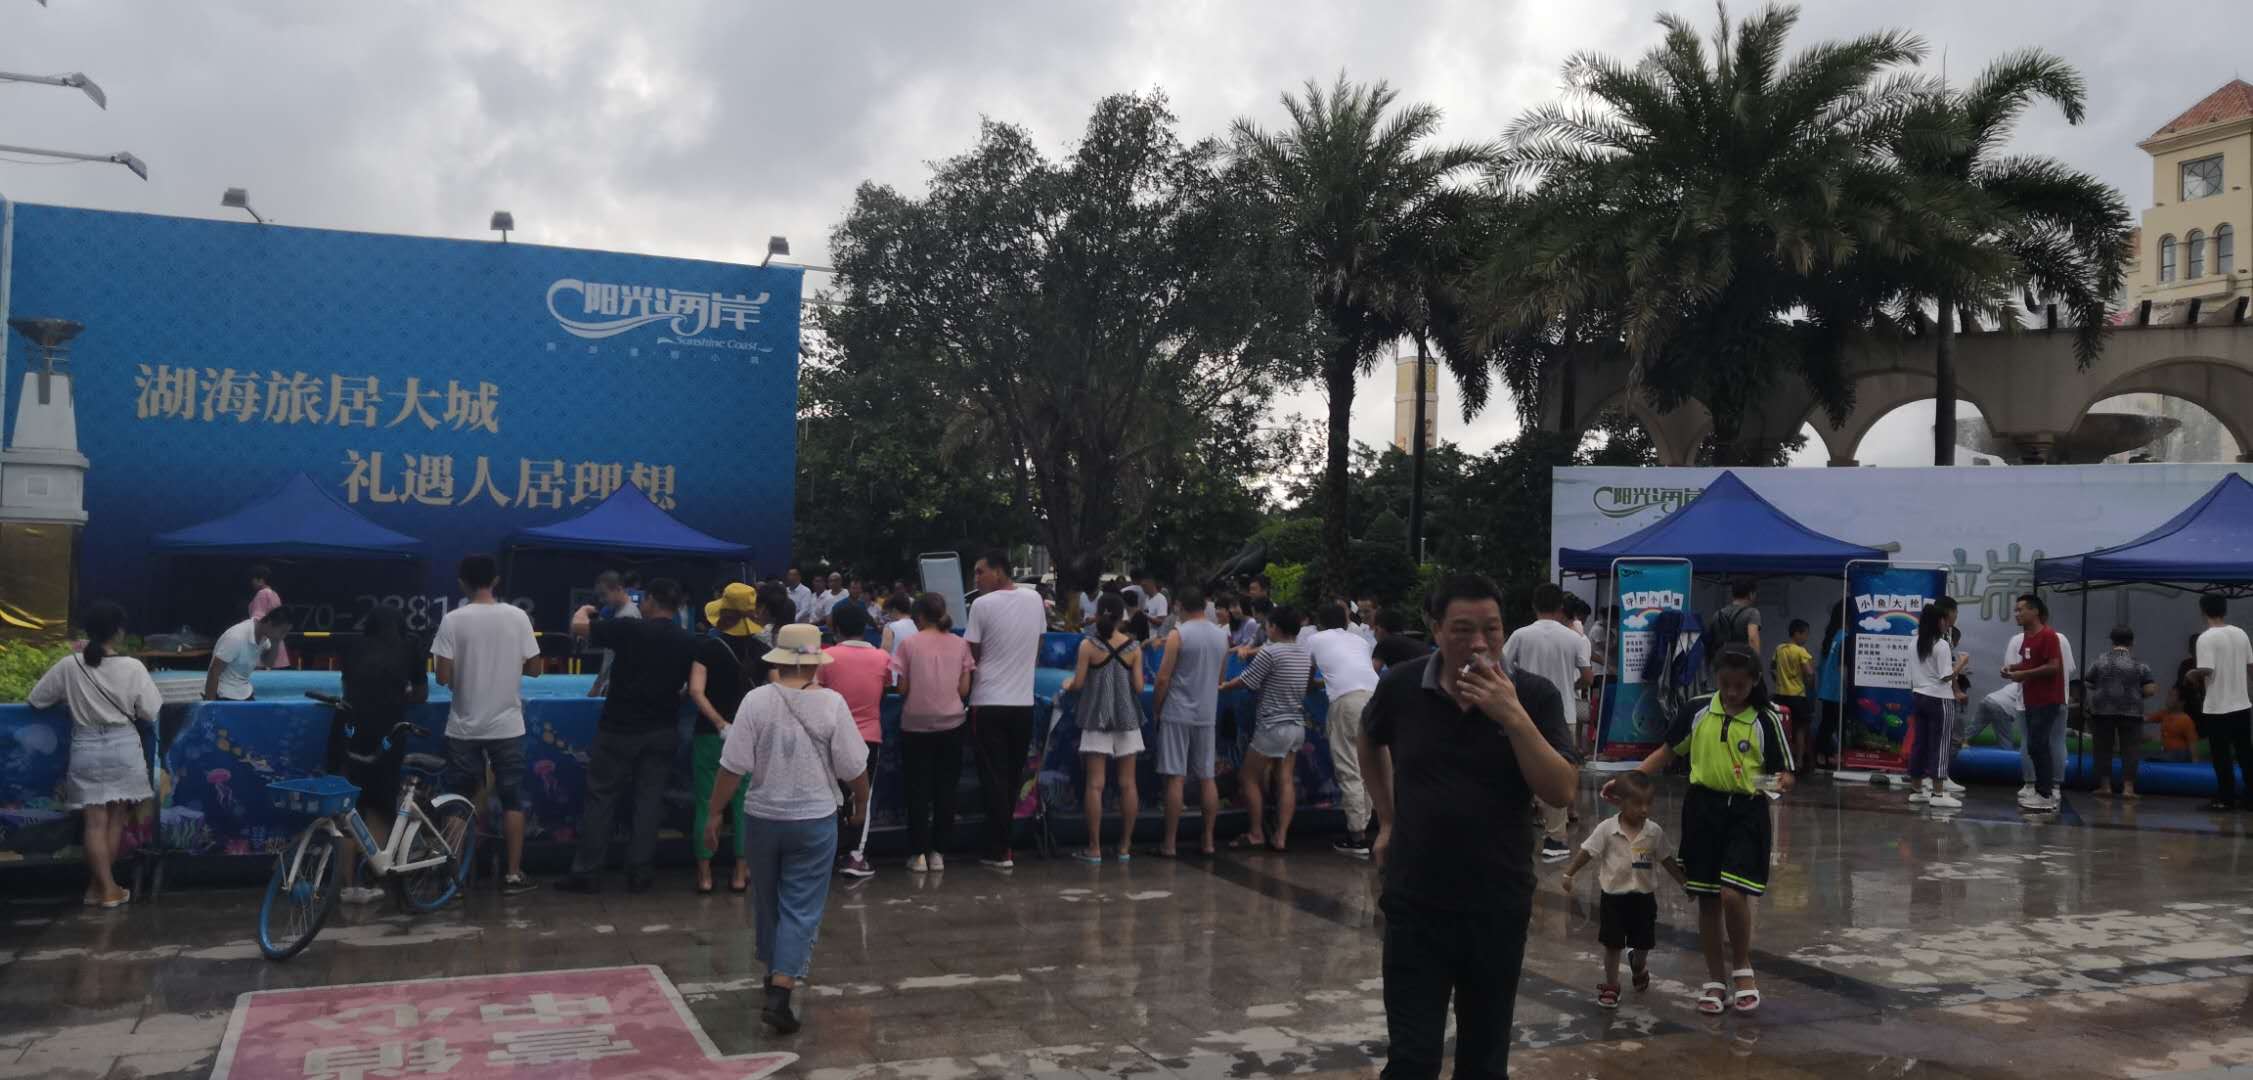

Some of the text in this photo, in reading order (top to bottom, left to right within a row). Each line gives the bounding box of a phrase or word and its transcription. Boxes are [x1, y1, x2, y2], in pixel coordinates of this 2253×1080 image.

[562, 279, 770, 338] 阳光海岸
[676, 337, 758, 352] Sunshine Coast
[134, 363, 500, 434] 湖海旅居大城
[340, 449, 676, 511] 礼遇人居理想
[308, 992, 608, 1036] 中心
[303, 1023, 639, 1080] 营销
